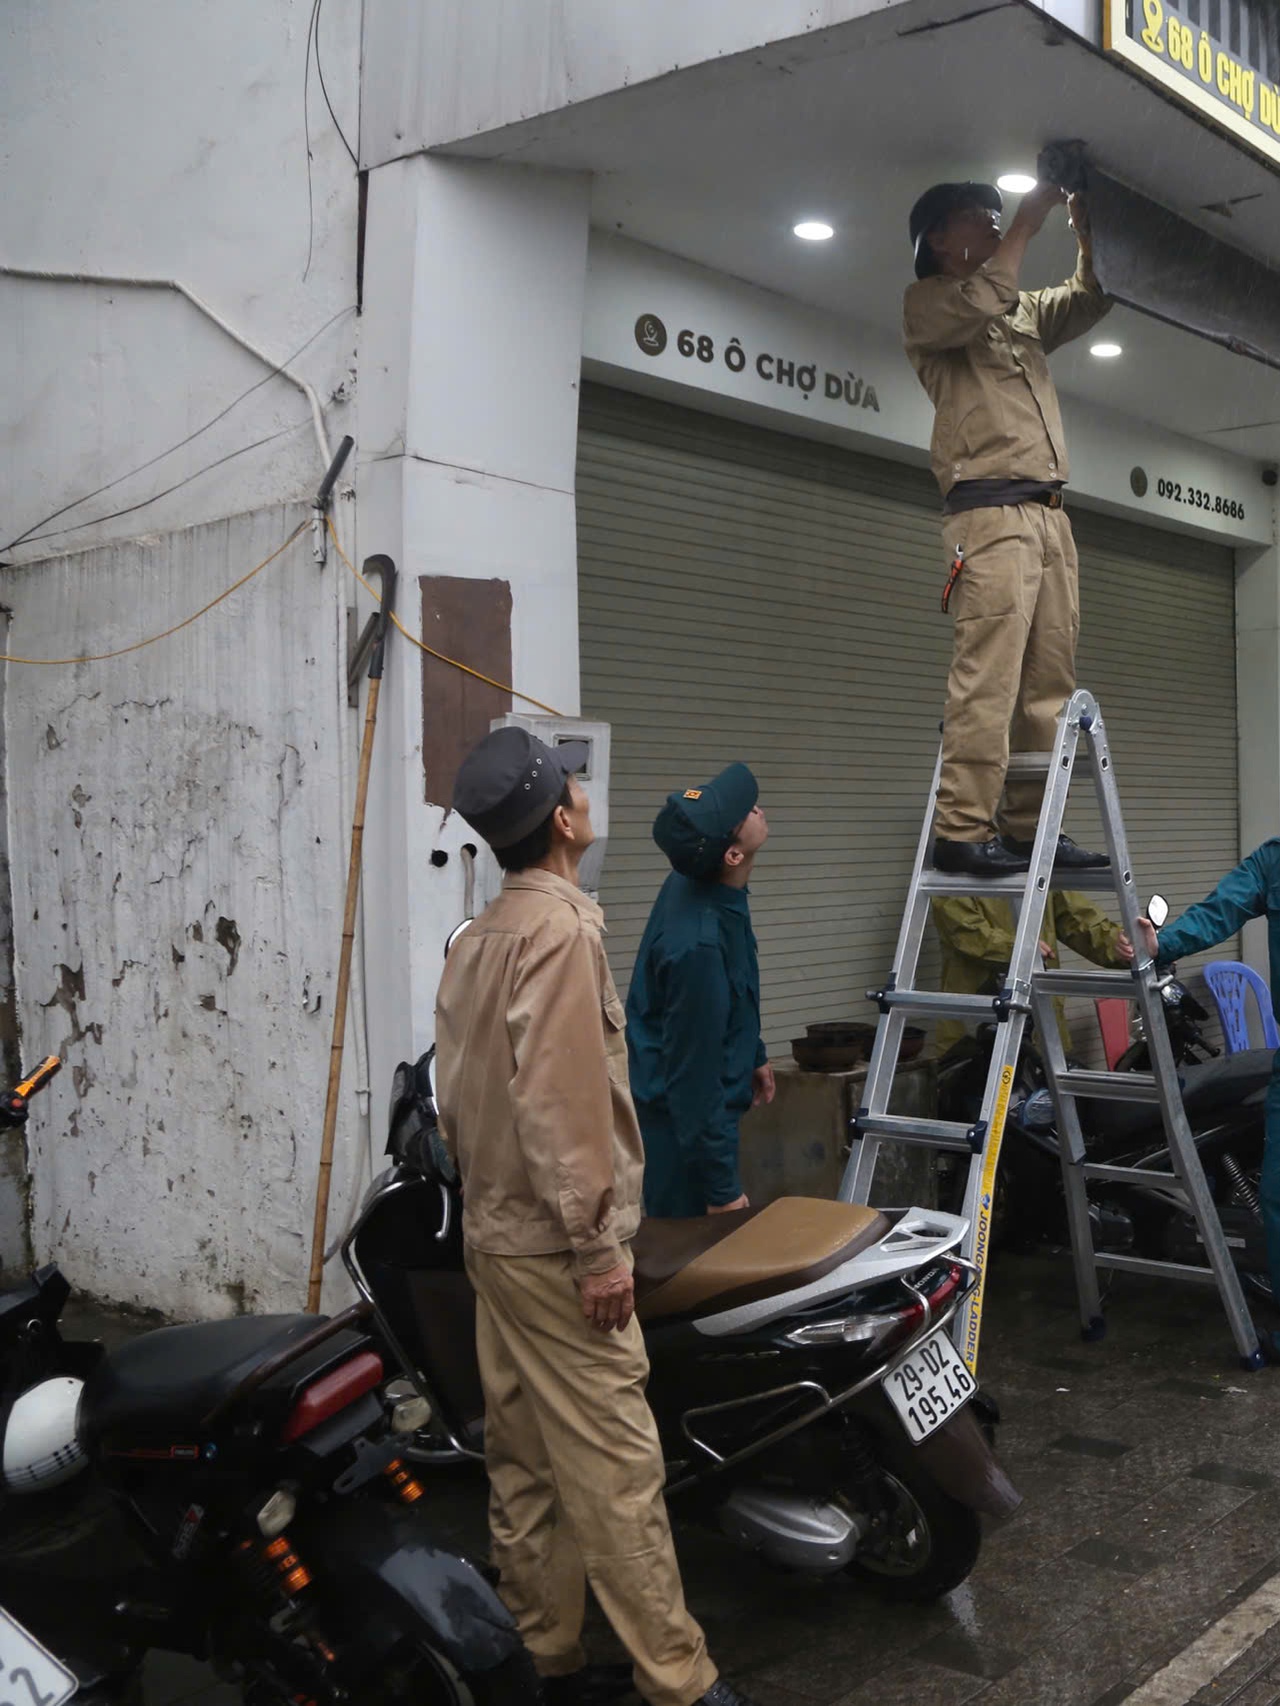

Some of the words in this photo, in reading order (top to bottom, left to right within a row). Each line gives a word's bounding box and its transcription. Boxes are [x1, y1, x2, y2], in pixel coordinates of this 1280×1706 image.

[1167, 16, 1194, 70] 68
[1198, 31, 1212, 84] Ô
[1216, 52, 1255, 120] CHỢ
[677, 330, 714, 363] 68
[724, 337, 746, 372] Ô
[756, 354, 816, 400] CHỢ
[825, 371, 880, 413] DỪA
[1157, 478, 1245, 520] 092.332.8686
[914, 1268, 940, 1290] HONDA
[965, 1210, 988, 1362] JOONGAG-LADDER
[894, 1339, 950, 1402] 29-D2
[908, 1364, 971, 1434] 195.46
